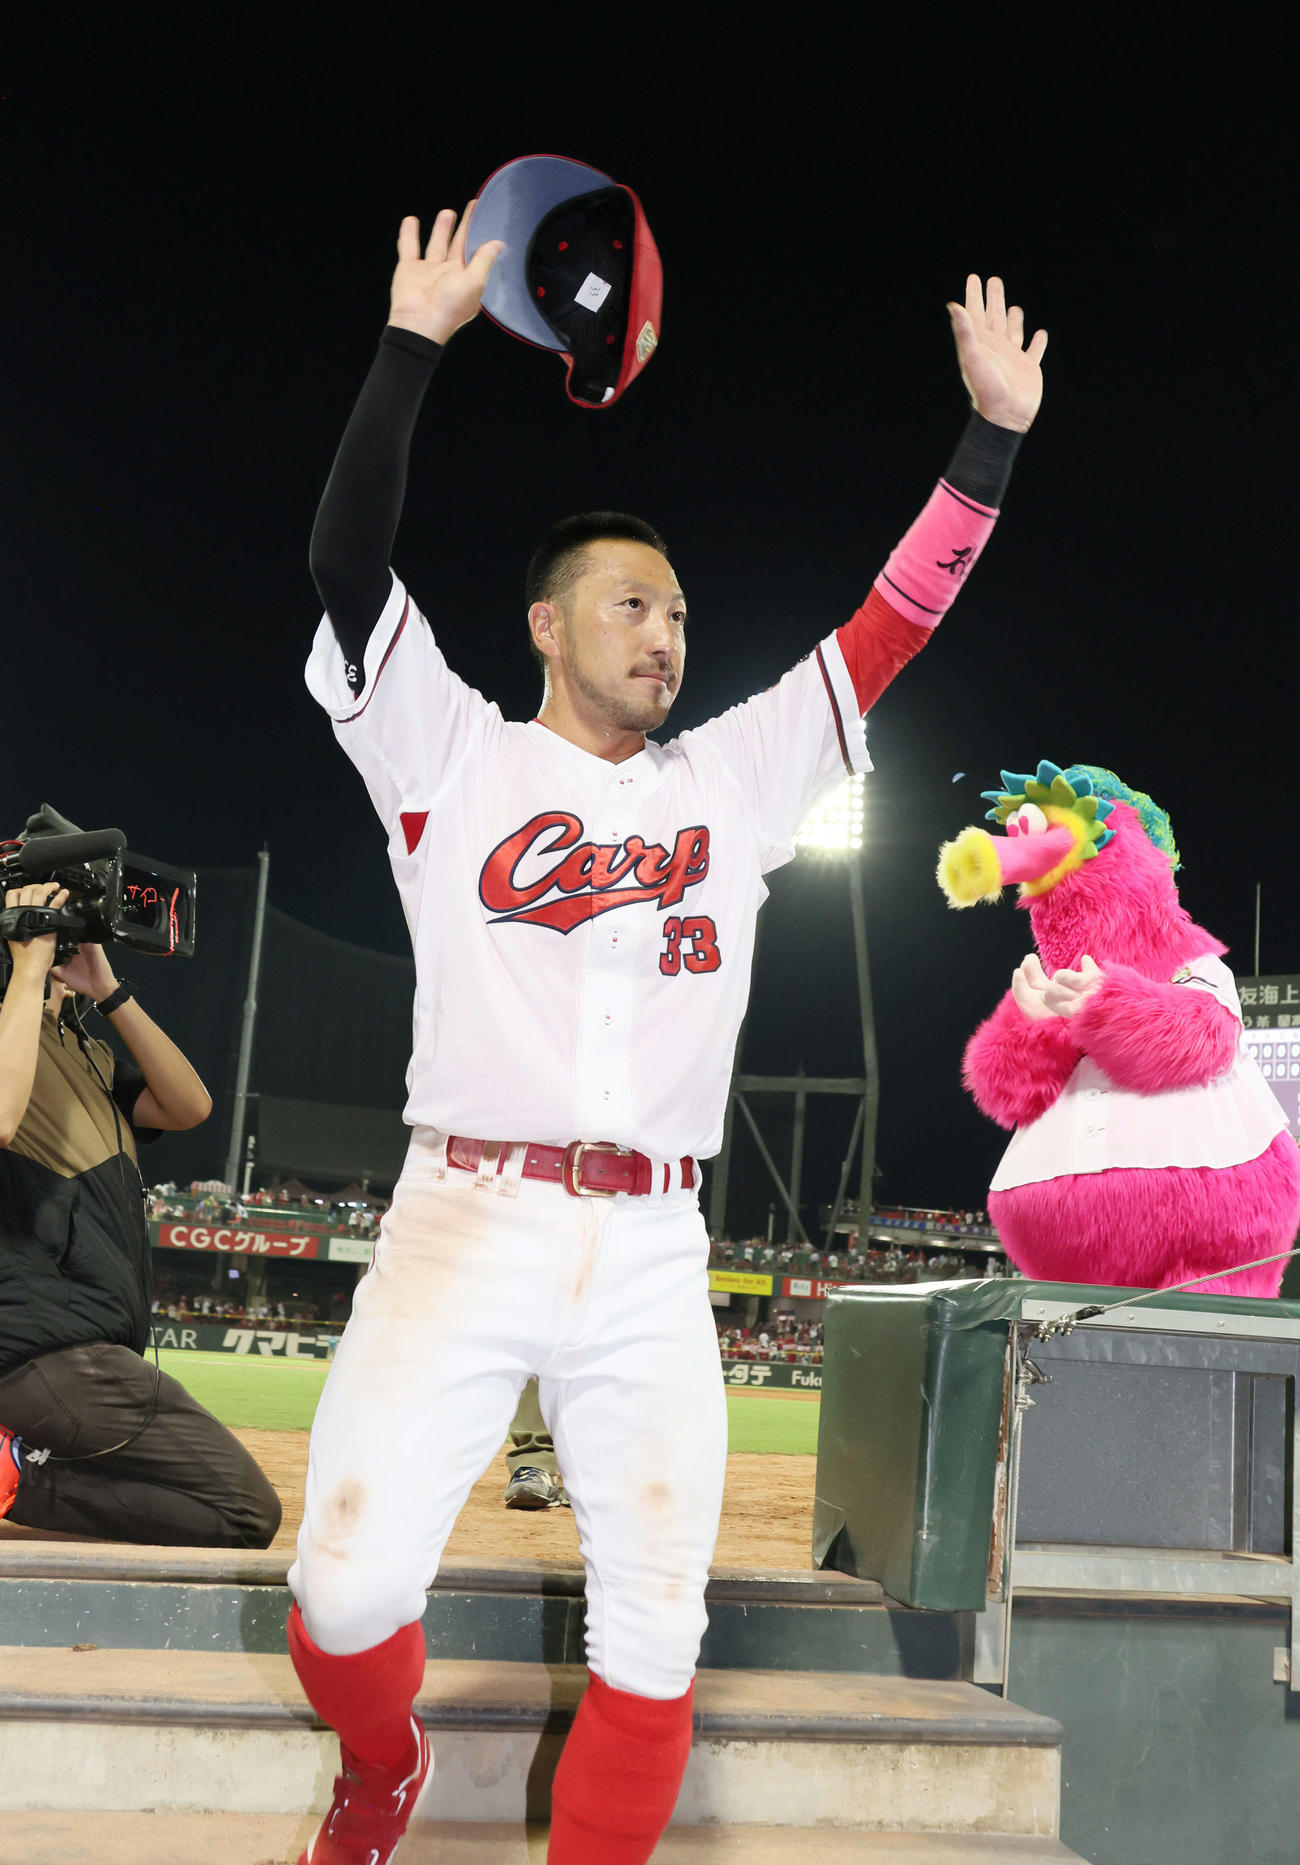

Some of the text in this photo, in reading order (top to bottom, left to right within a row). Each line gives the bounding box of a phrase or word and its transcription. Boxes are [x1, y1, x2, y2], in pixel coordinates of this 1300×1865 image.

[478, 810, 710, 934] Carp
[659, 915, 722, 976] 33
[1239, 983, 1300, 1006] 友海上
[169, 1226, 310, 1256] CGCグループ
